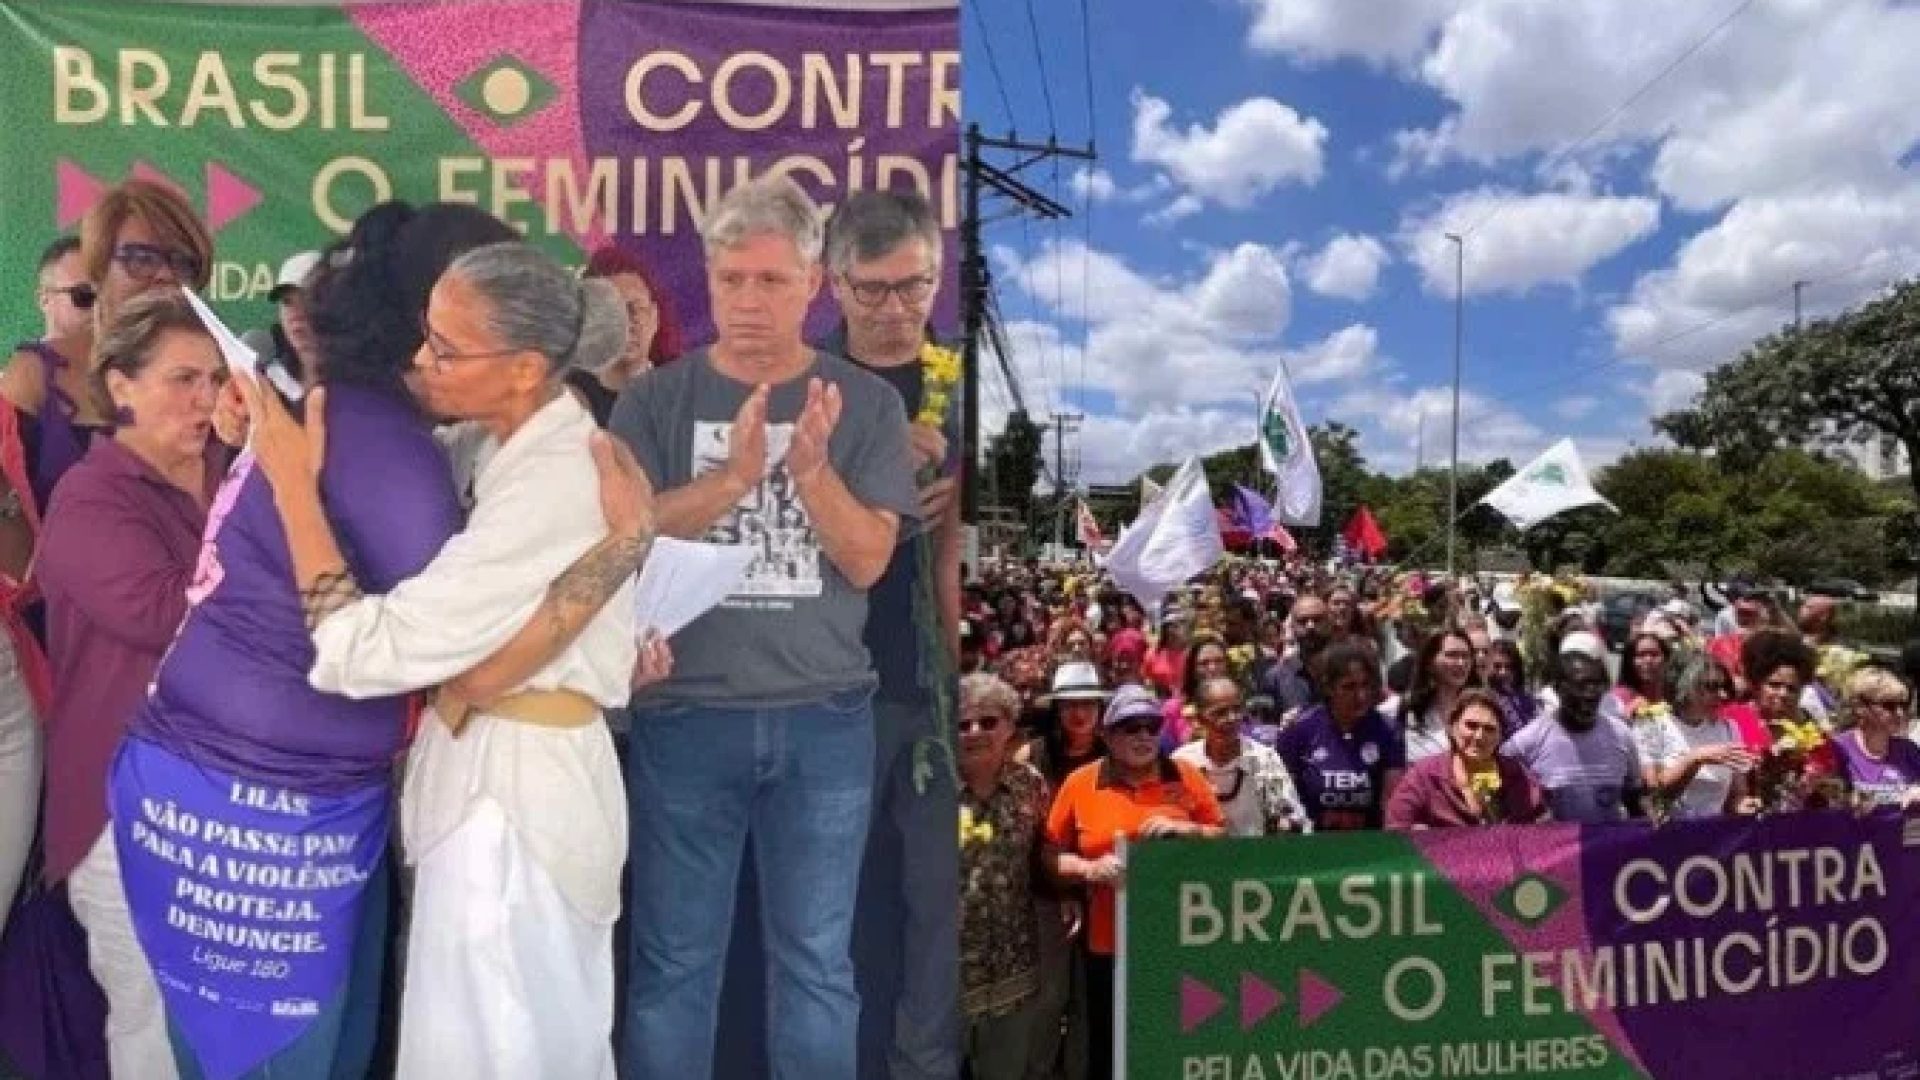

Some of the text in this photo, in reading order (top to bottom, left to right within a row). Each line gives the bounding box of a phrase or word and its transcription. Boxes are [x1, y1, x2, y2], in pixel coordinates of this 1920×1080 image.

[53, 45, 390, 131] BRASIL
[311, 155, 393, 234] O
[209, 261, 274, 300] IDA
[1321, 770, 1370, 790] TEM
[132, 820, 193, 869] PARA
[199, 853, 220, 879] A
[141, 798, 199, 837] NÃO
[203, 819, 297, 856] PASSE
[1179, 843, 1887, 946] BRASIL CONTRA
[167, 905, 327, 953] DENUNCIE.
[192, 946, 291, 979] Ligue 180
[1383, 914, 1889, 1021] O FEMINICÍDIO
[1275, 1048, 1357, 1080] VIDA
[1364, 1043, 1434, 1080] DAS
[1441, 1034, 1609, 1076] MULHERES
